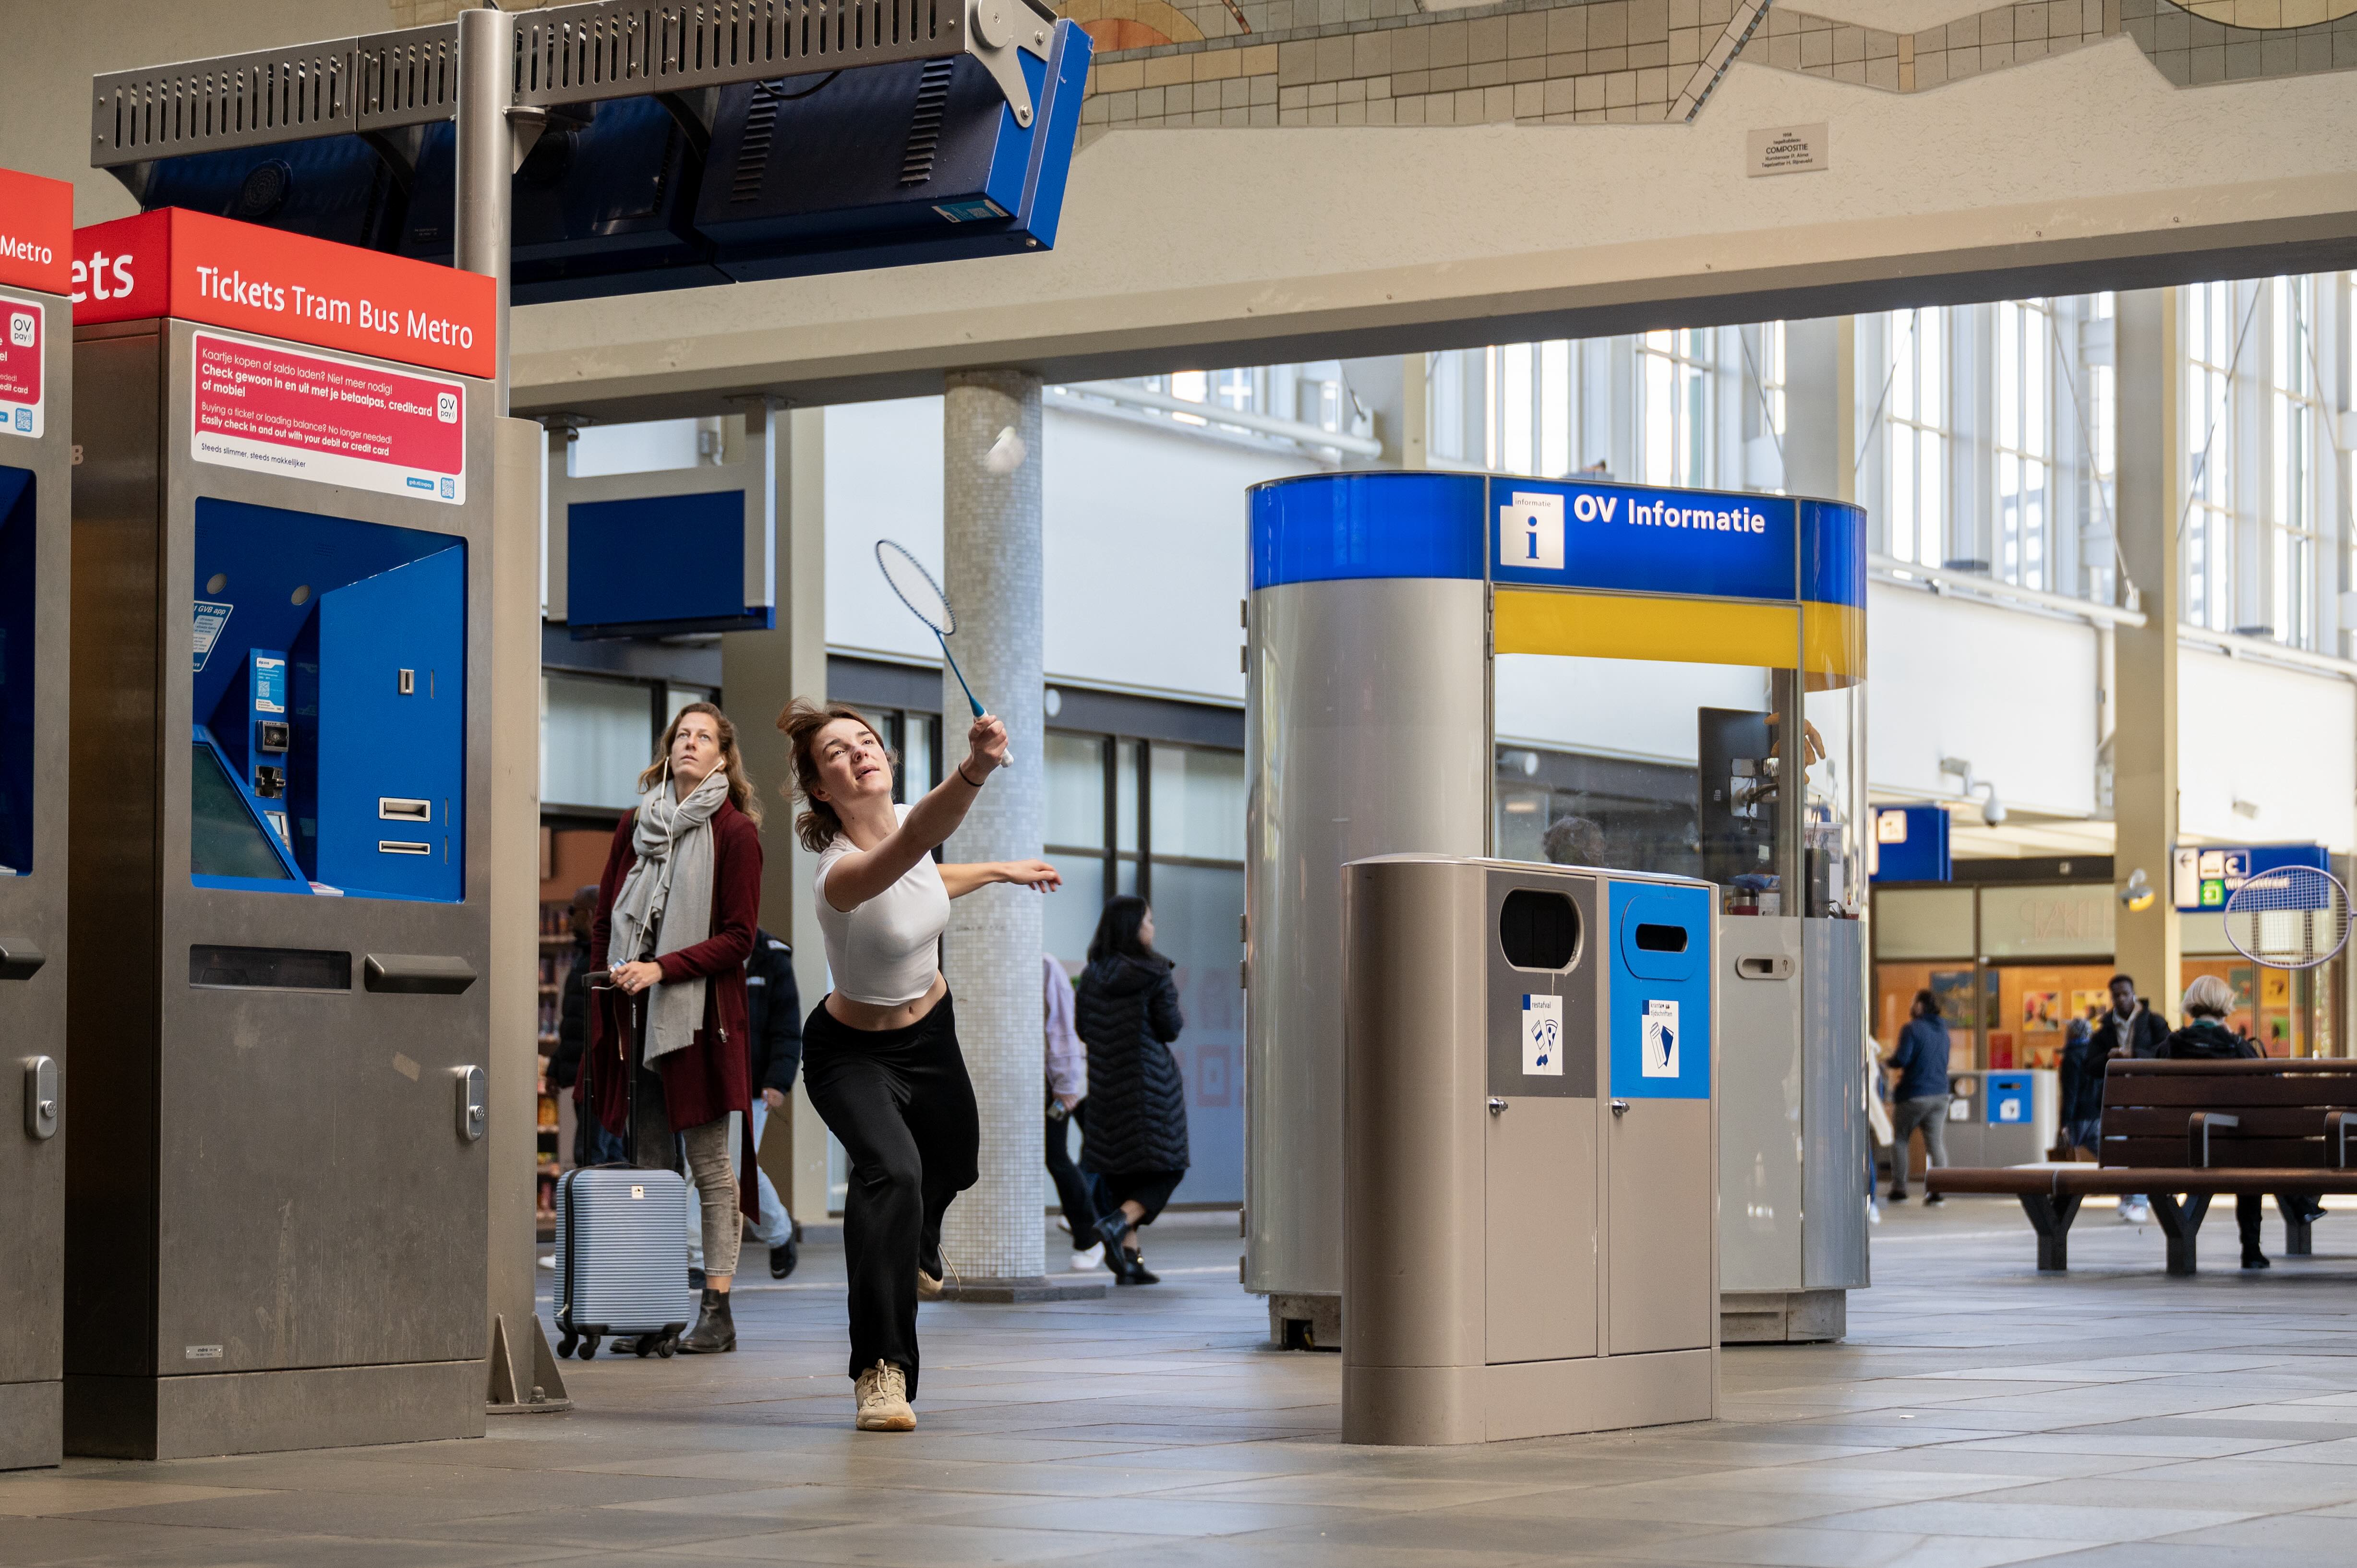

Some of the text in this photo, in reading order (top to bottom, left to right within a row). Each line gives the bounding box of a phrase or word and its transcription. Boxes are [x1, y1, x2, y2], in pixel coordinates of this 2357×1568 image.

[1766, 144, 1808, 154] COMPOSITIE
[0, 235, 52, 264] Metro
[72, 251, 134, 303] ets
[196, 266, 473, 349] Tickets Tram Bus Metro
[14, 319, 32, 332] OV
[14, 332, 27, 342] pay
[203, 348, 392, 395] Kaartje kopen of saldo laden? Niet meer nodig!
[13, 386, 28, 394] card
[202, 380, 245, 397] of mobiel
[202, 363, 433, 417] Check gewoon in en uit met je betaalpas, creditcard
[440, 398, 455, 410] OV
[441, 410, 452, 419] pay
[202, 401, 226, 416] Buying
[235, 408, 254, 419] ticket
[265, 413, 291, 428] loading
[293, 419, 326, 431] balance?
[328, 425, 338, 434] No
[340, 427, 361, 439] longer
[363, 432, 392, 444] needed!
[202, 414, 223, 428] Easily
[225, 419, 248, 431] check
[250, 423, 256, 432] in
[258, 426, 273, 435] and
[275, 429, 286, 438] out
[289, 431, 302, 441] with
[305, 434, 320, 444] your
[322, 436, 340, 447] debit
[351, 442, 371, 453] credit
[373, 446, 389, 456] card
[202, 443, 306, 468] Steeds slimmer, steeds makkelijker
[1515, 498, 1551, 507] informatie
[1574, 494, 1766, 534] OV Informatie
